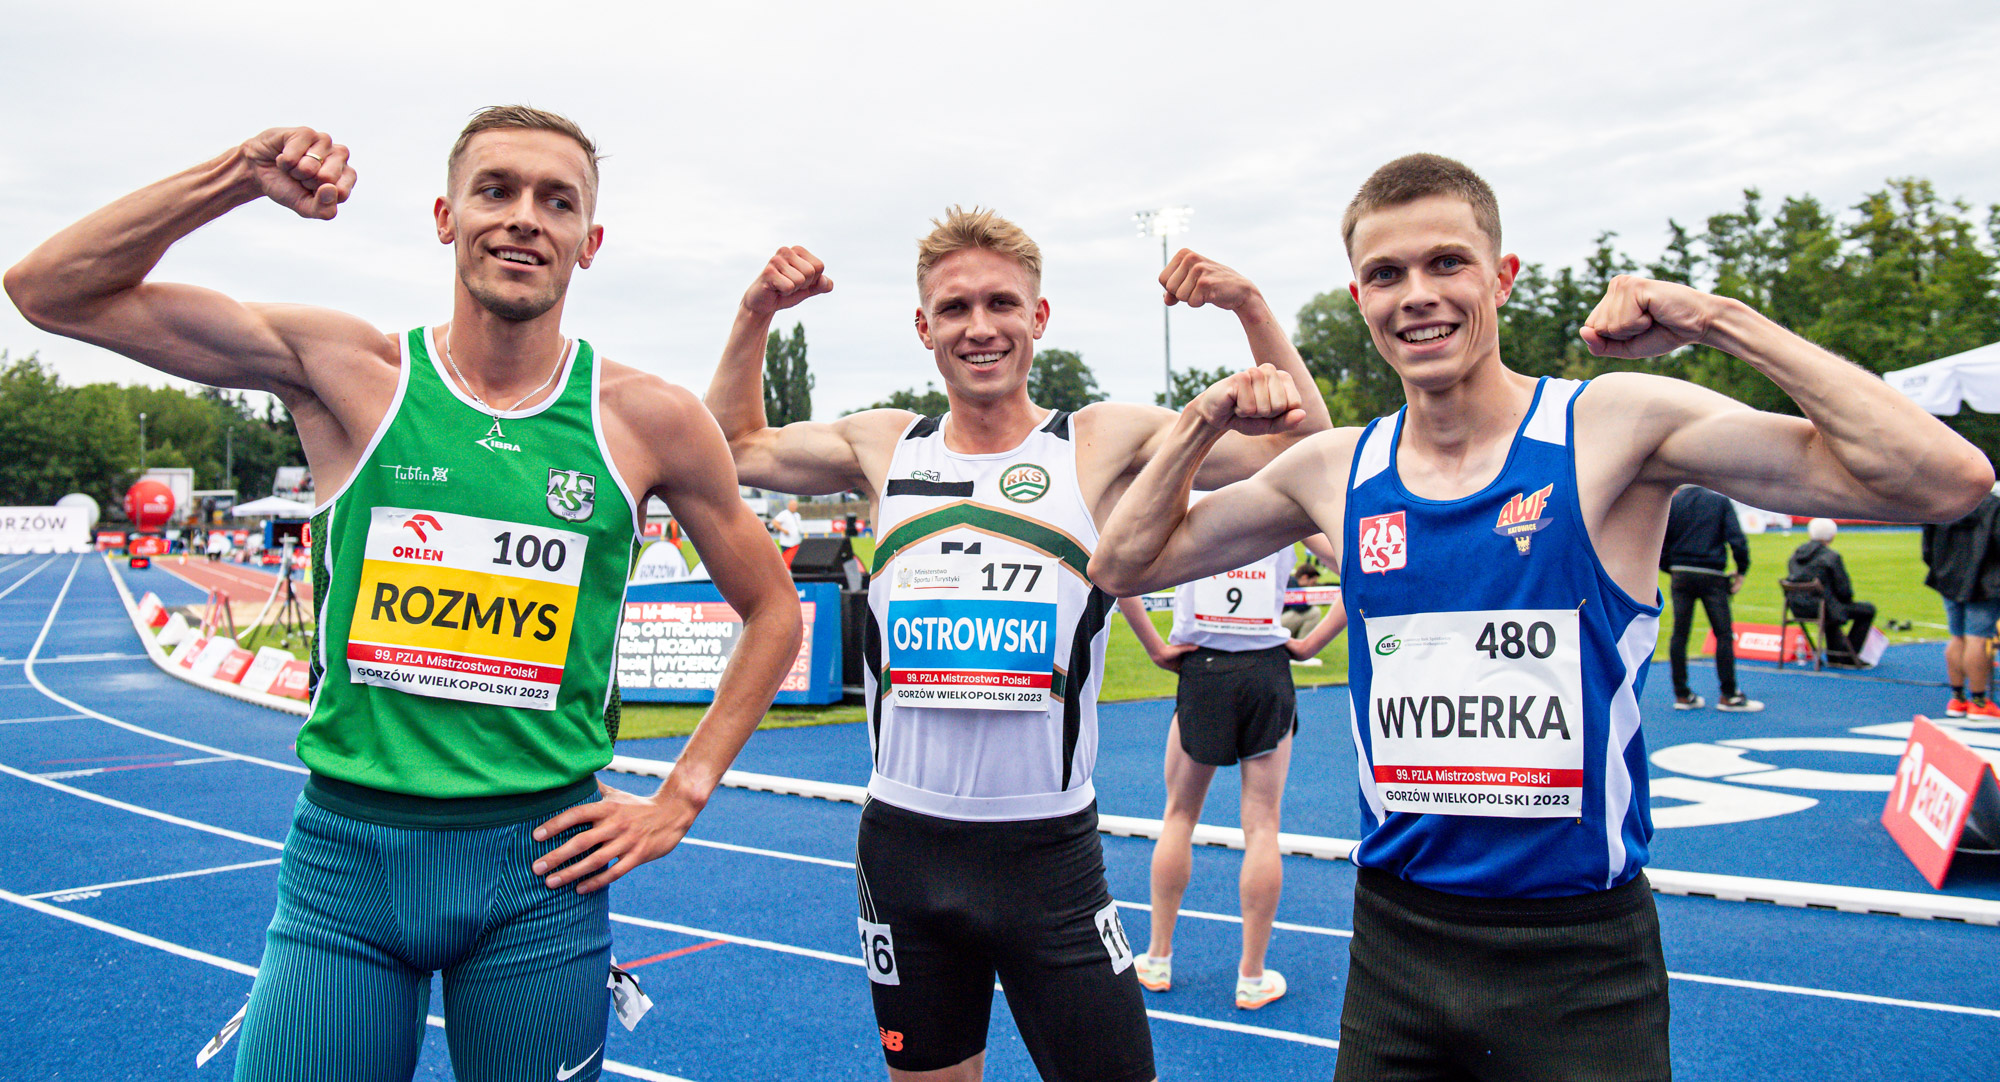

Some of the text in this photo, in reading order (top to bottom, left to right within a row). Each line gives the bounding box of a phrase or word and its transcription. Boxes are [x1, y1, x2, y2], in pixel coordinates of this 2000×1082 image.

[485, 421, 505, 438] A
[1007, 469, 1042, 486] RKS
[1496, 483, 1554, 528] AWF
[0, 513, 67, 531] RZÓW
[1507, 523, 1537, 534] KATOWICE
[392, 545, 444, 562] ORLEN
[492, 531, 567, 573] 100
[913, 576, 931, 584] Sportu
[934, 575, 960, 584] Turystyki
[981, 563, 1043, 593] 177
[1227, 570, 1266, 580] ORLEN
[1226, 587, 1243, 614] 9
[370, 582, 560, 642] ROZMYS
[641, 622, 733, 638] OSTROWSKI
[893, 617, 1048, 654] OSTROWSKI
[656, 638, 722, 655] ROZMYS
[1475, 621, 1557, 660] 480
[374, 649, 539, 680] 99. PZLA Mistrzostwa Polski
[653, 655, 728, 672] WYDERKA
[357, 667, 550, 700] GORZÓW WIELKOPOLSKI 2023
[906, 673, 1031, 686] 99. PZLA Mistrzostwa Polski
[897, 688, 1042, 702] GORZÓW WIELKOPOLSKI 2023
[1377, 695, 1571, 740] WYDERKA
[1396, 769, 1551, 785] 99. PZLA Mistrzostwa Polski
[1386, 788, 1570, 806] GORZÓW WIELKOPOLSKI 2023
[1917, 774, 1960, 837] ORLEN
[860, 929, 894, 976] 16
